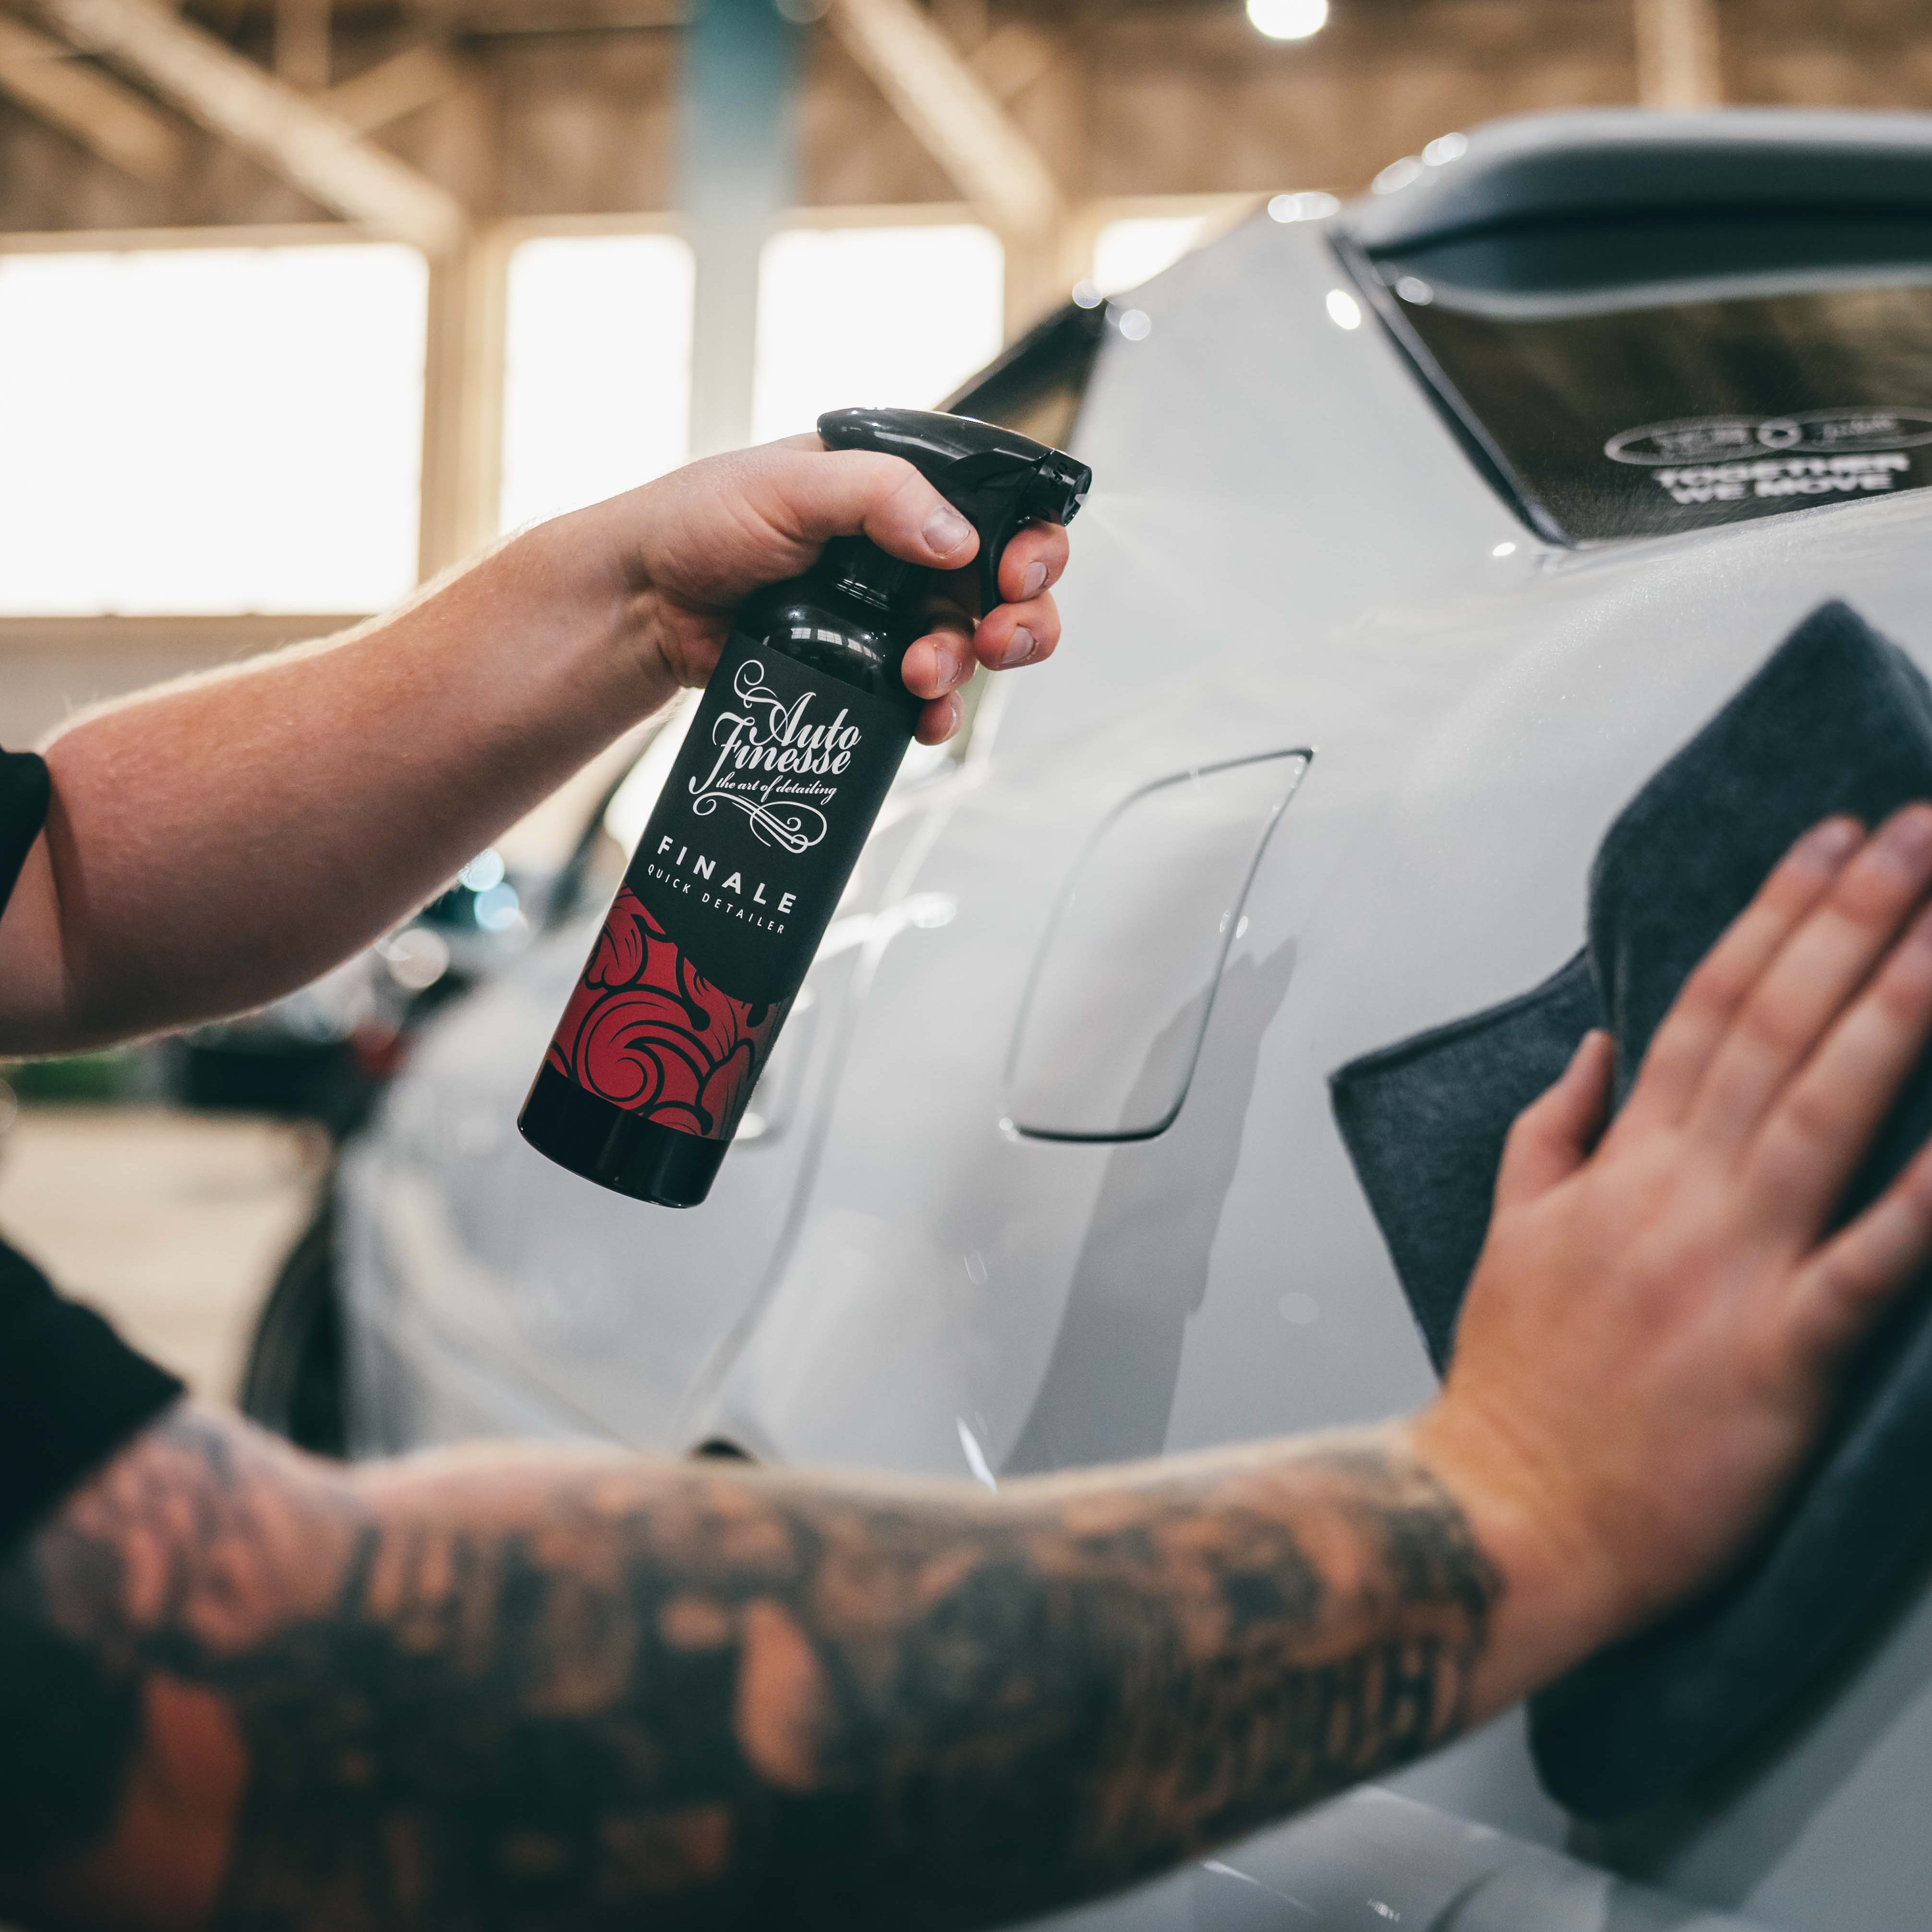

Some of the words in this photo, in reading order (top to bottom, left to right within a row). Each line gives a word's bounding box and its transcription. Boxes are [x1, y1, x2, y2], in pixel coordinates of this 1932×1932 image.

[1654, 453, 1909, 488] TOGETHER
[1671, 482, 1746, 504] WE
[1755, 473, 1893, 497] MOVE
[744, 687, 862, 750] Auto
[688, 712, 852, 794] Finesse
[716, 771, 736, 789] the
[737, 780, 760, 791] art
[760, 775, 783, 803] of
[776, 779, 837, 805] detailing
[648, 864, 691, 894] QUICK
[701, 892, 785, 934] DETAILER
[657, 835, 797, 914] FINALE
